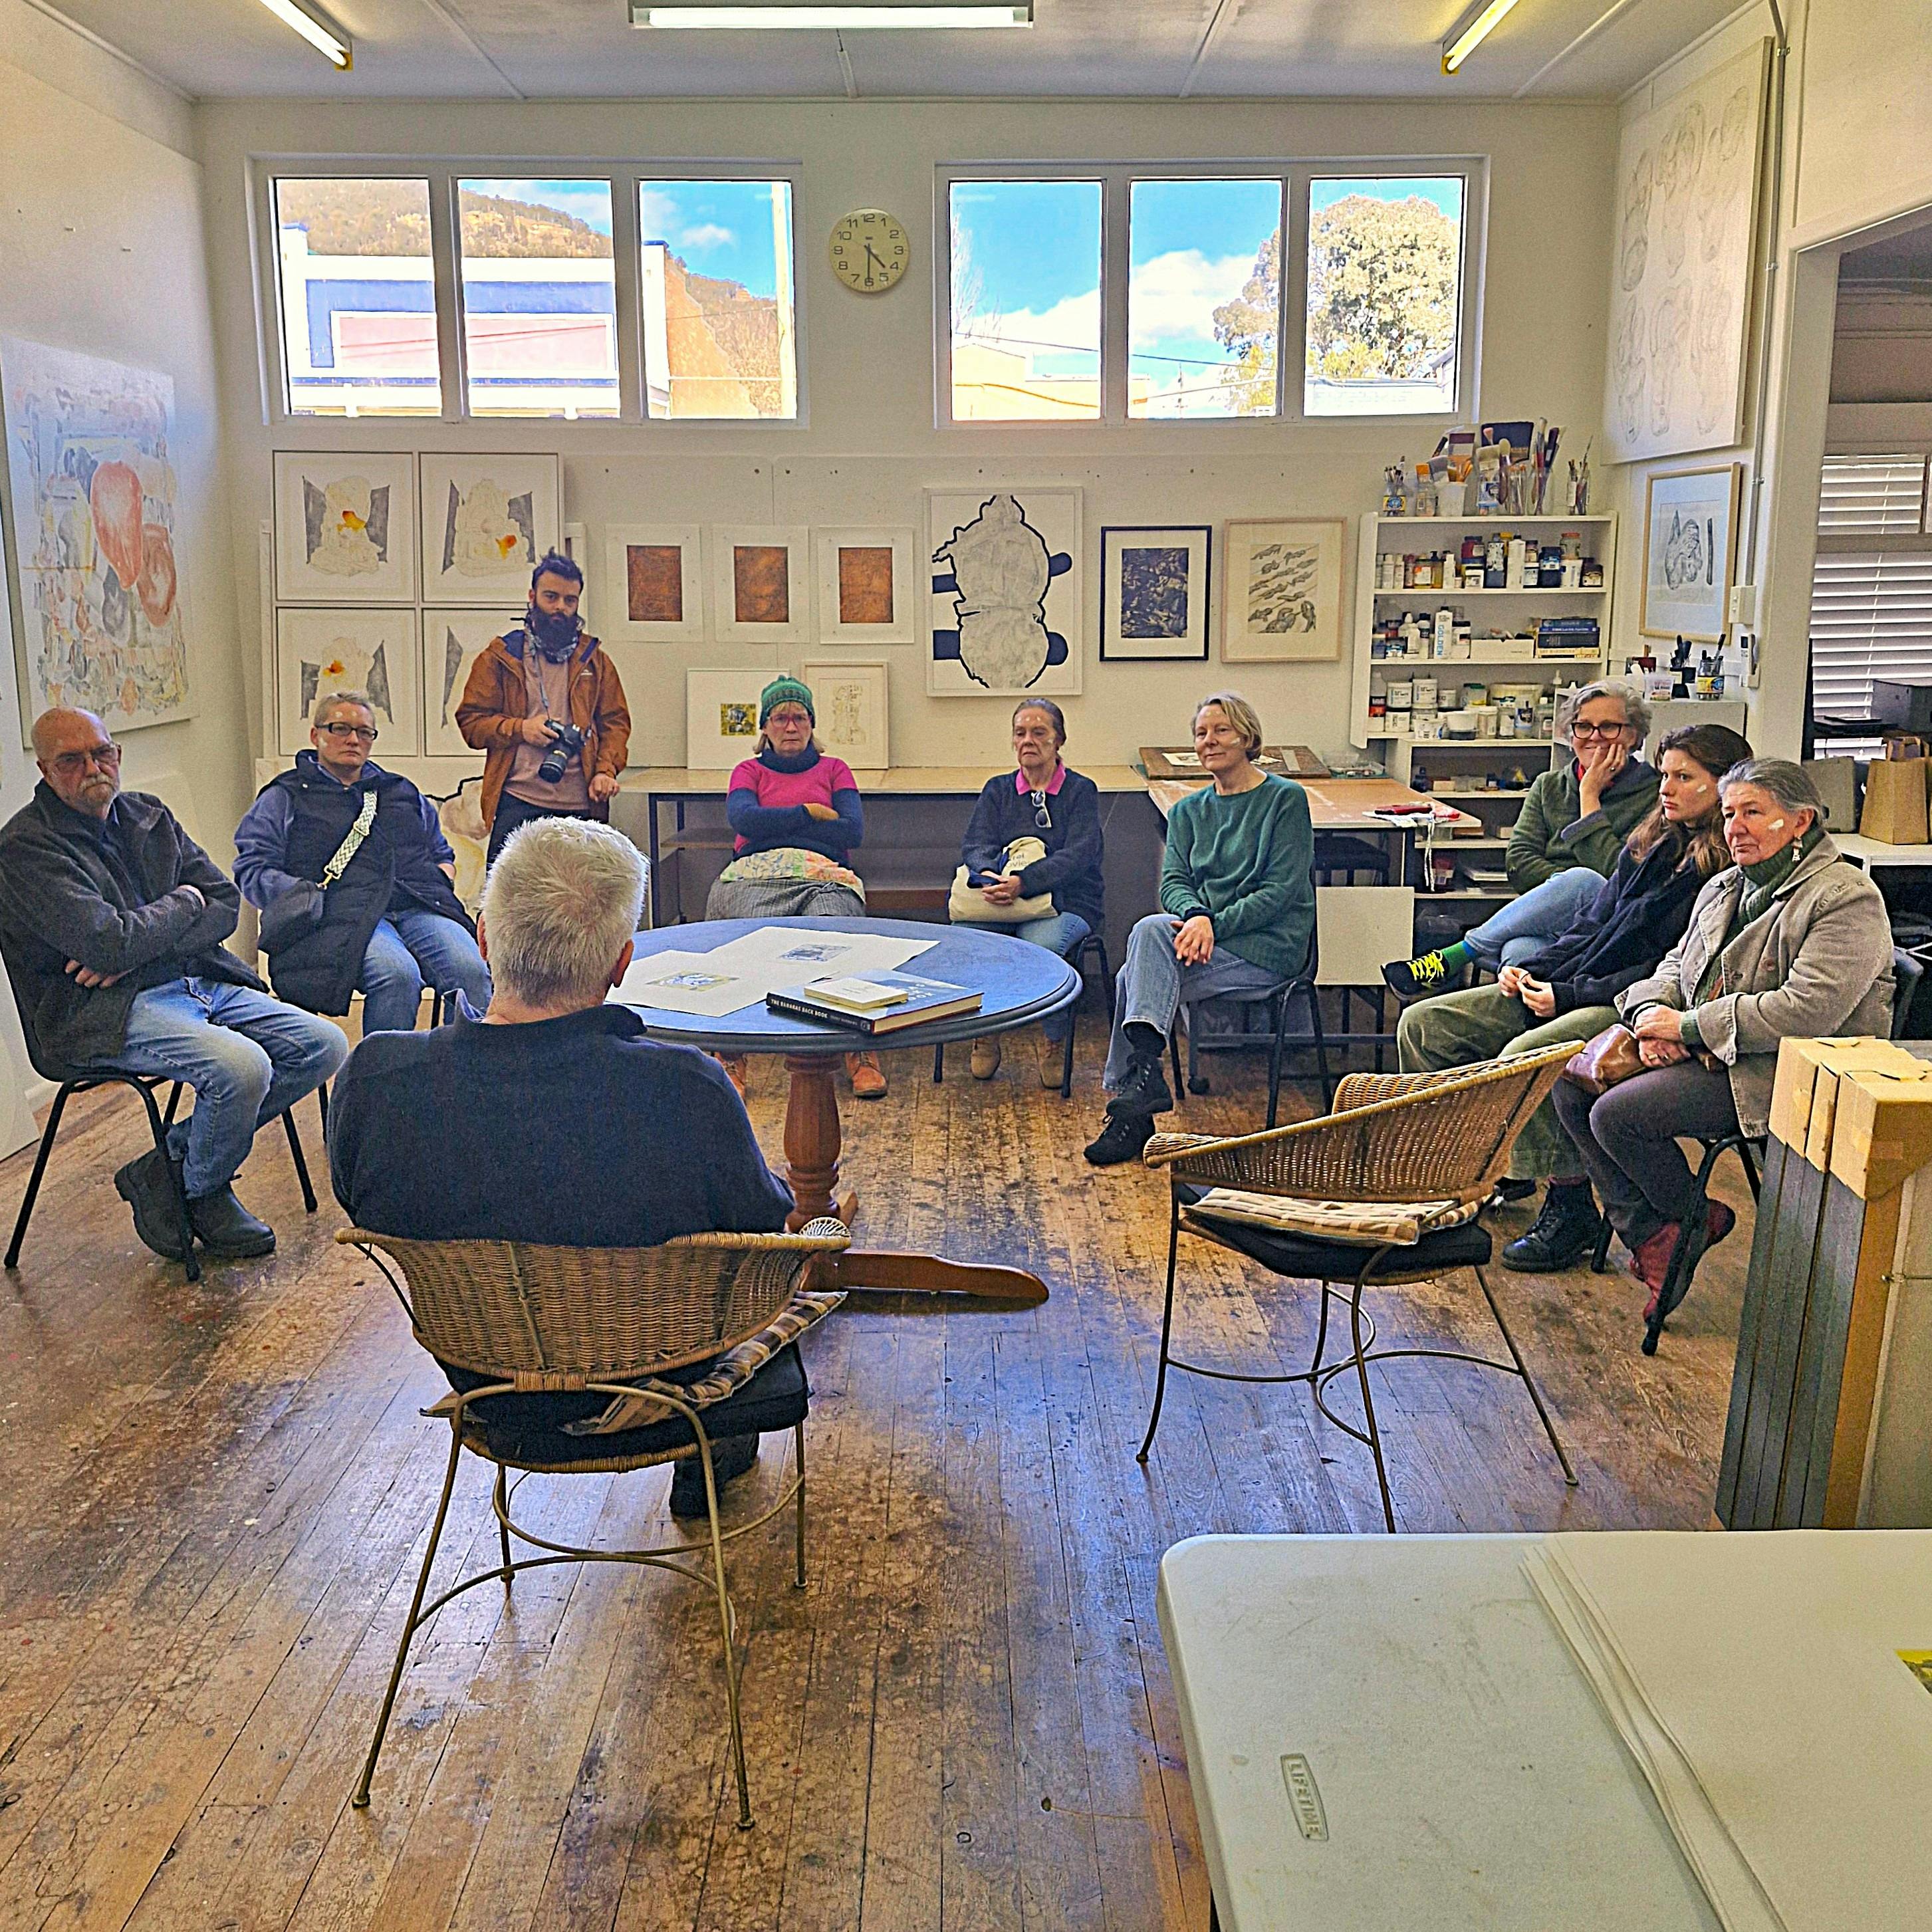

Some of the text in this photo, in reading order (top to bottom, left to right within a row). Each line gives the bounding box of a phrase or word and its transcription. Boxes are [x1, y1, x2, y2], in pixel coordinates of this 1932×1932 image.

[861, 213, 876, 223] 12
[880, 218, 886, 227] 1
[846, 219, 858, 228] 11
[837, 231, 852, 240] 10
[890, 230, 900, 239] 2
[834, 246, 843, 255] 9
[894, 246, 904, 255] 3
[838, 261, 848, 270] 8
[890, 261, 899, 271] 4
[850, 273, 860, 283] 7
[864, 277, 874, 287] 6
[879, 273, 889, 282] 5
[1288, 1762, 1322, 1836] LIFETIME
